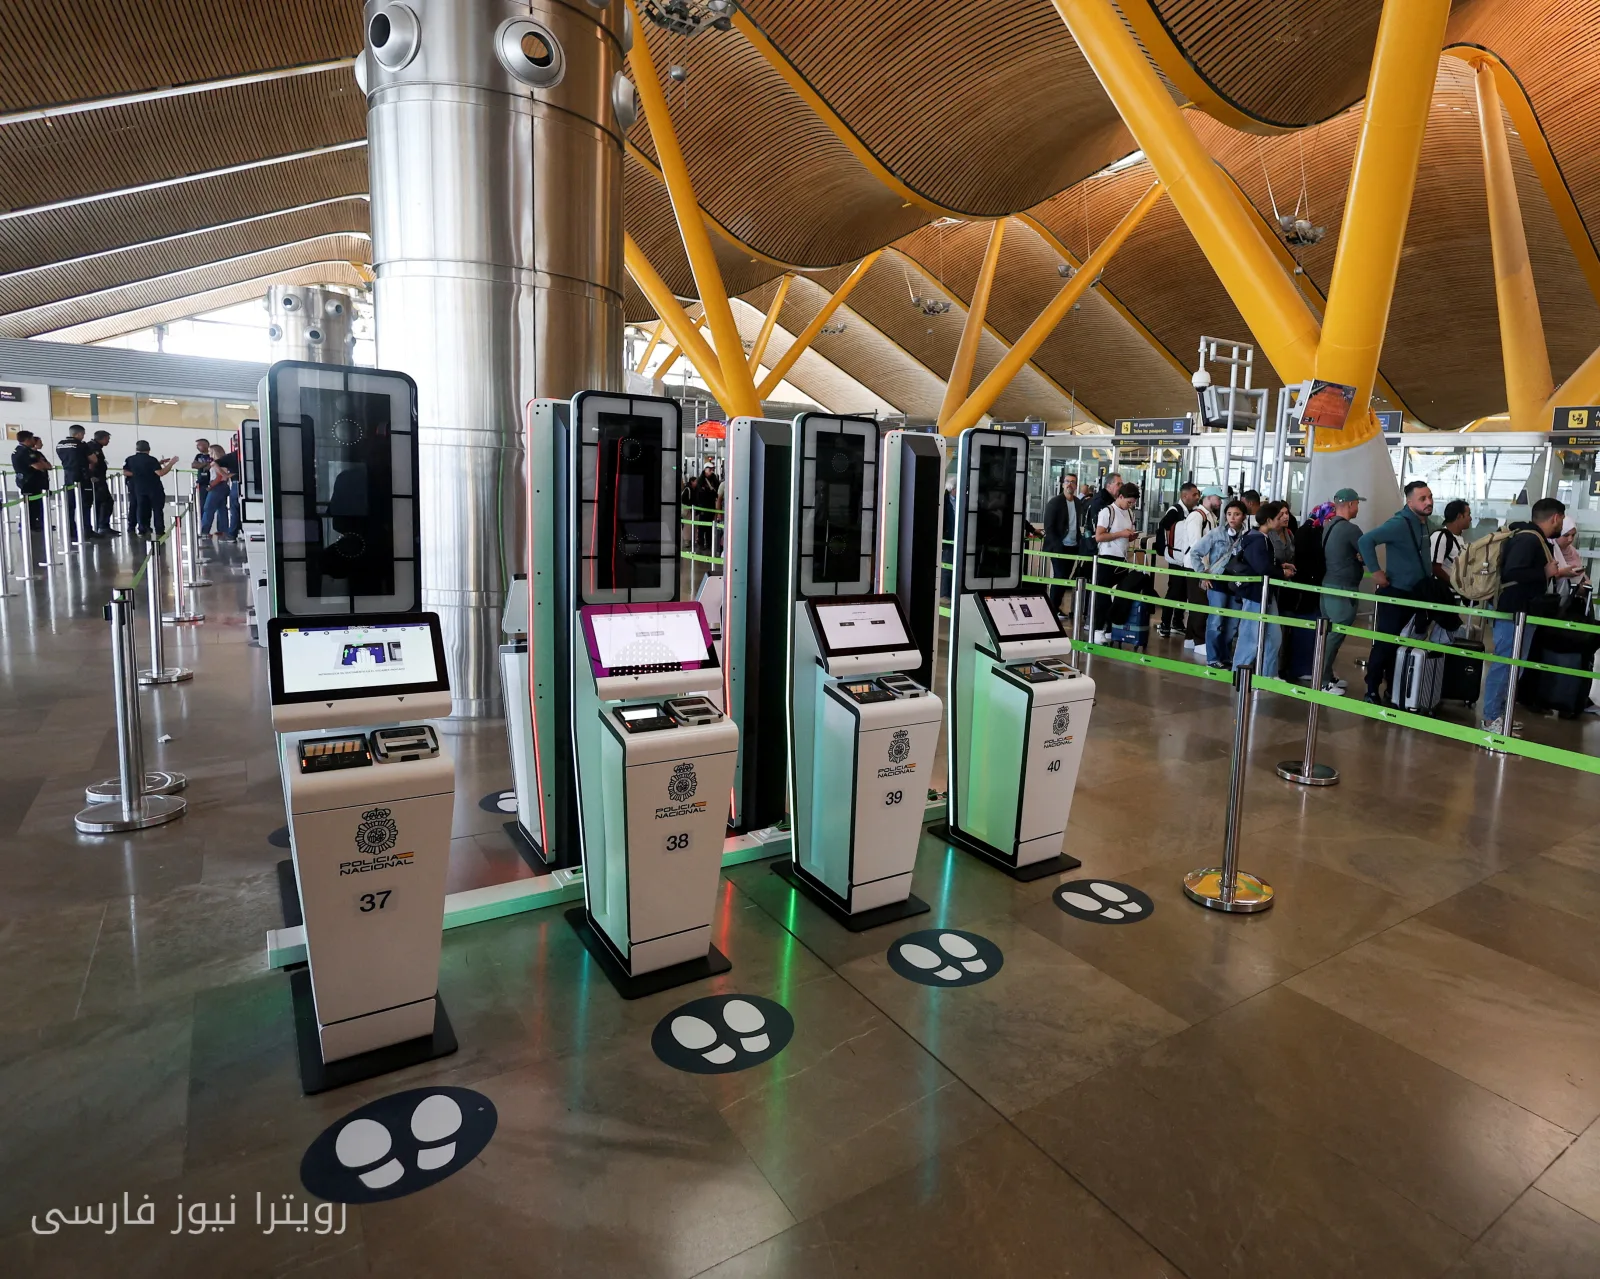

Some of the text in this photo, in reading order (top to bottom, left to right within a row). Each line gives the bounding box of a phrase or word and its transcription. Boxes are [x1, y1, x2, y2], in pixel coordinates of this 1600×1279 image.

[1157, 467, 1167, 477] 10
[1594, 481, 1600, 494] 1
[878, 765, 908, 774] POLICIA
[1047, 759, 1061, 773] 40
[877, 769, 916, 779] NACIONAL
[885, 790, 903, 806] 39
[655, 803, 696, 815] POLICIA
[655, 808, 706, 820] NACIONAL
[666, 833, 689, 851] 38
[340, 854, 399, 869] POLICIA
[340, 859, 414, 876] NACIONAL
[359, 889, 392, 912] 37
